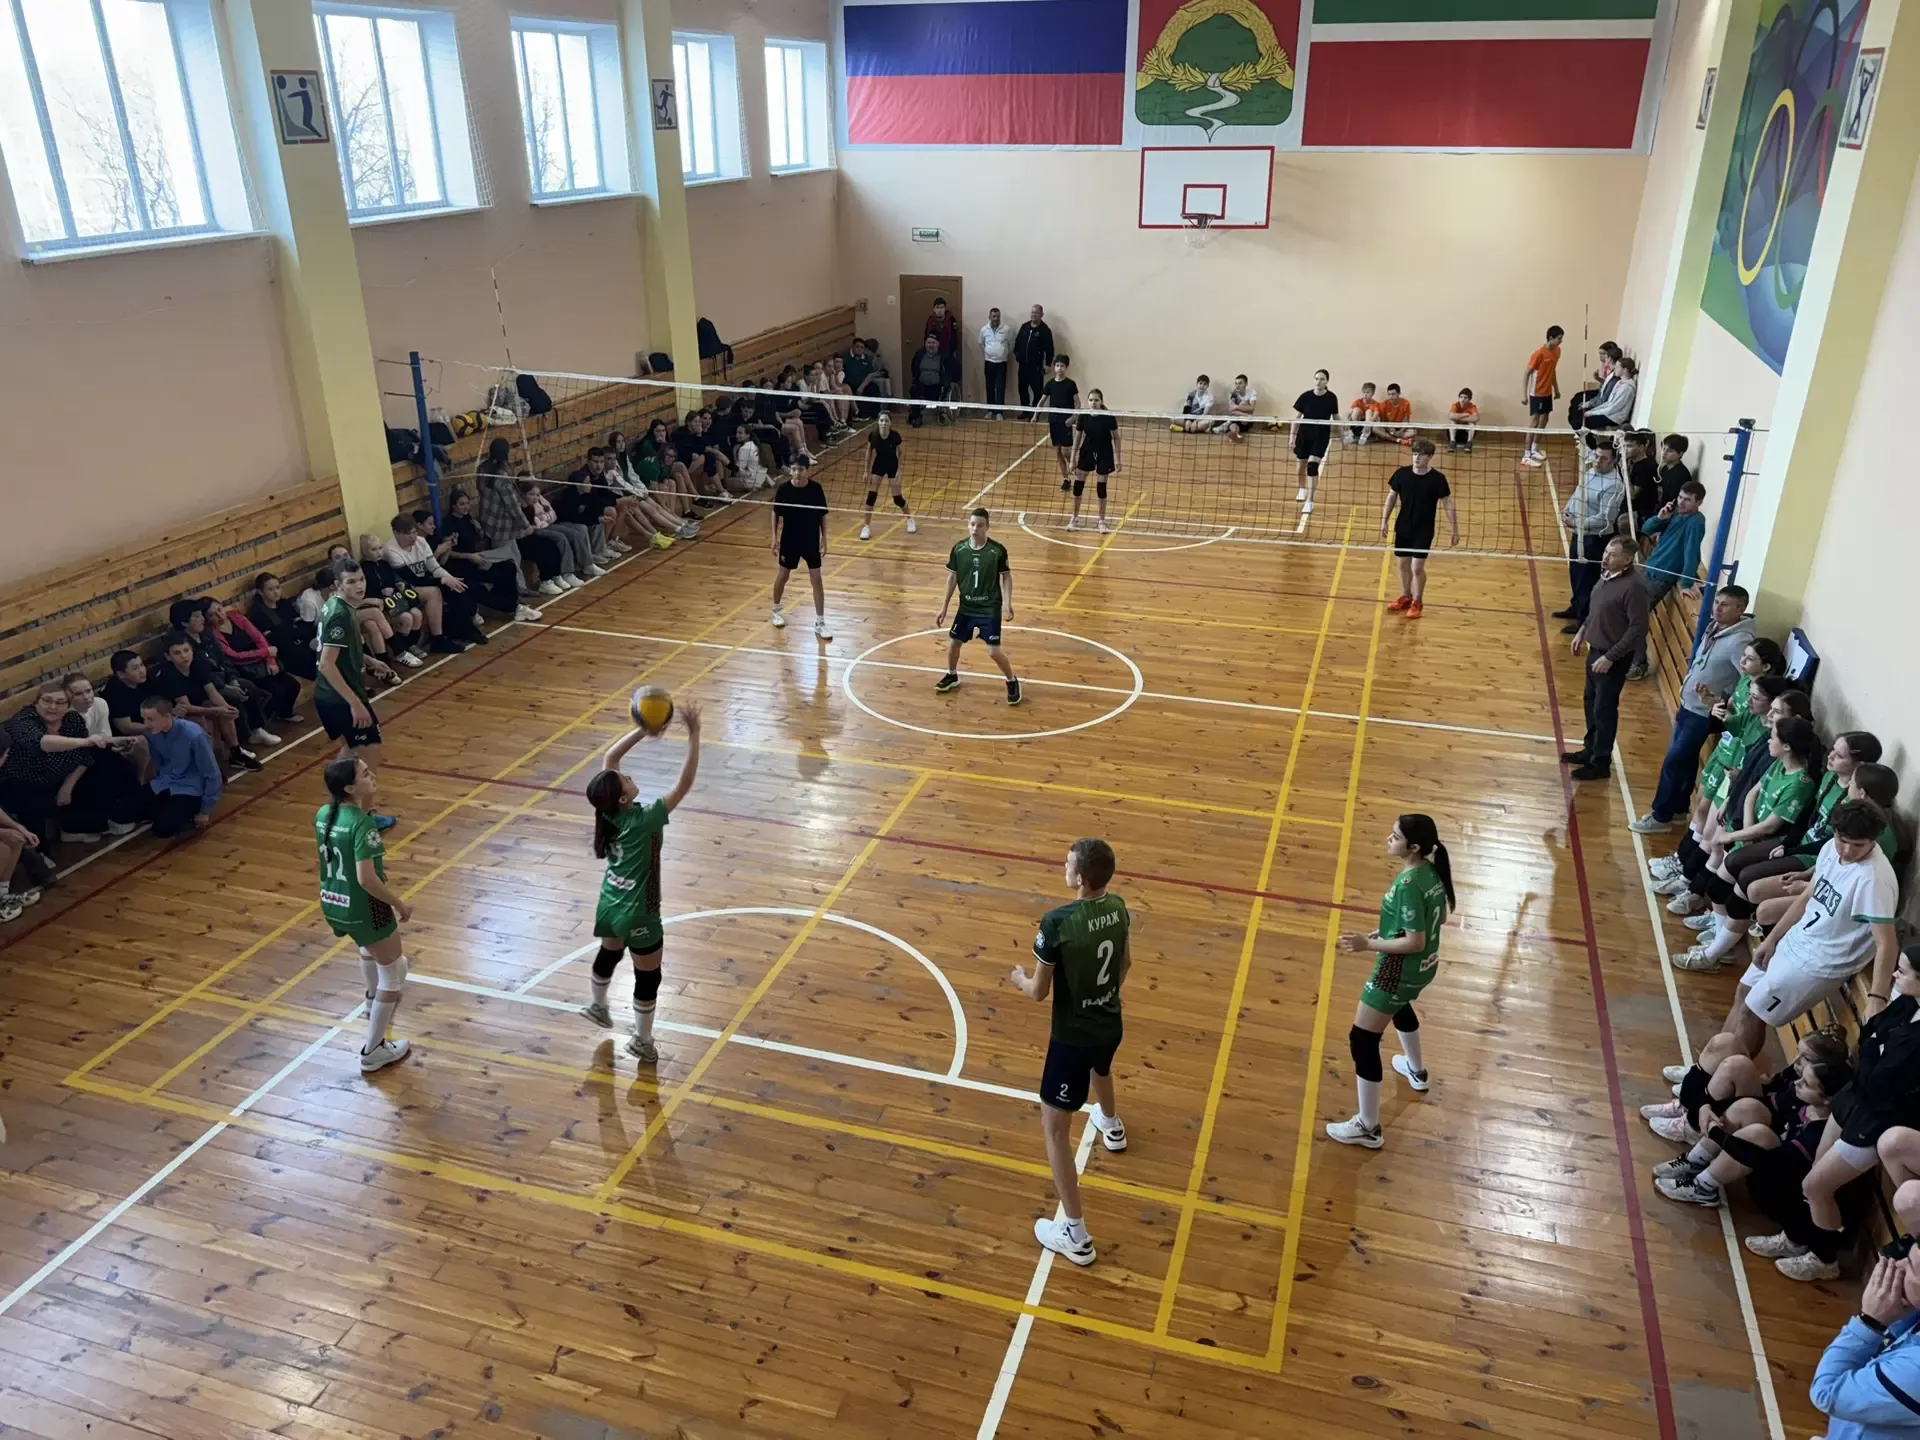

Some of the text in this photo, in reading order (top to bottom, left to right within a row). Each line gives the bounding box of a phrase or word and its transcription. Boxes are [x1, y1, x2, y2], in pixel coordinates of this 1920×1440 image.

[973, 570, 979, 589] 1
[319, 843, 347, 881] 12
[1087, 910, 1120, 933] КУРАЖ
[1803, 911, 1821, 931] 7
[1096, 940, 1114, 986] 2
[1767, 996, 1782, 1012] 7
[1060, 1083, 1069, 1097] 2
